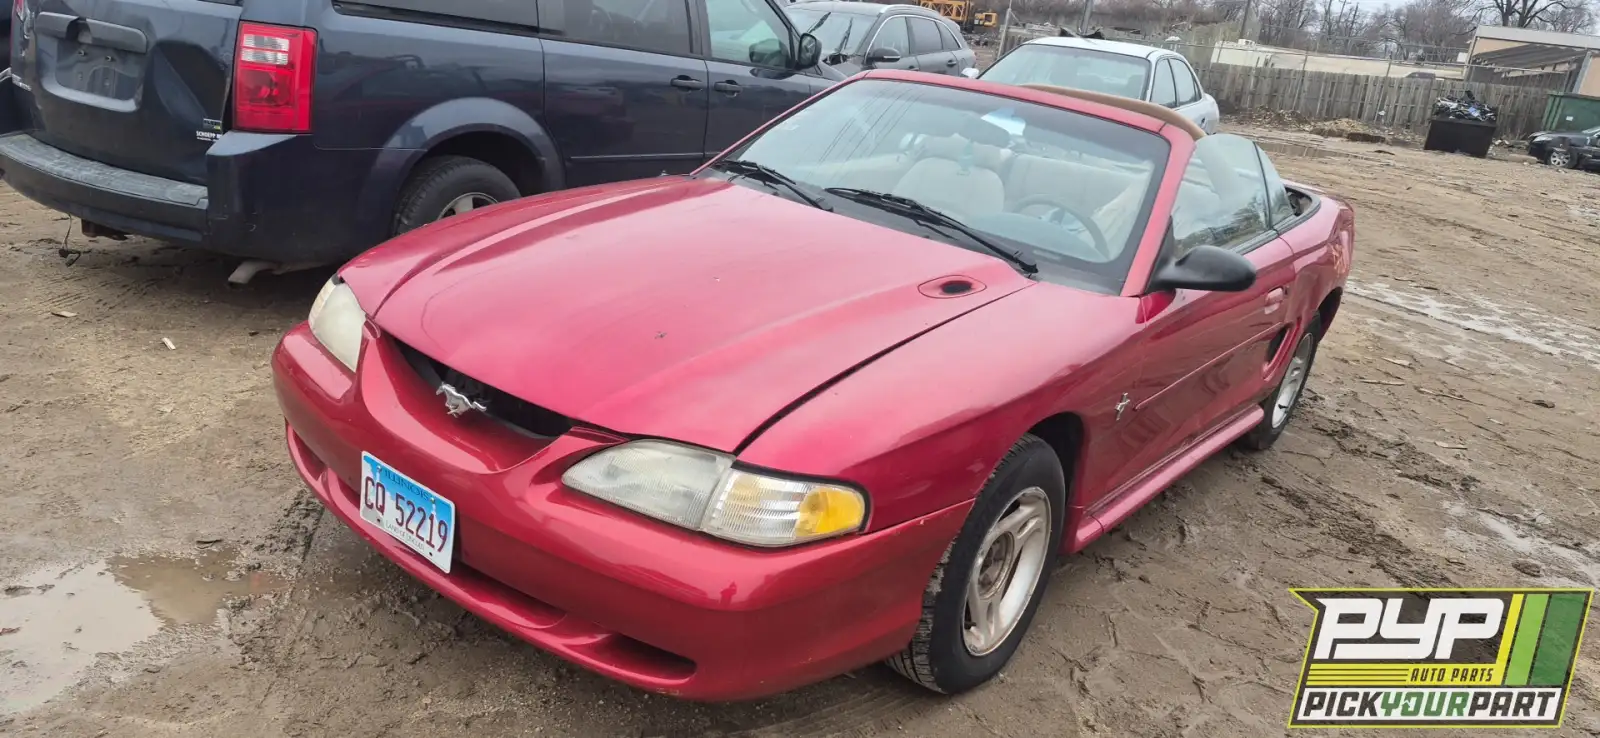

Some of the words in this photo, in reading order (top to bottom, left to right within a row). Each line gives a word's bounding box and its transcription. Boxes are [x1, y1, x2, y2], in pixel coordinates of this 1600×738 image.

[385, 470, 429, 500] ILLINOIS
[365, 476, 385, 515] CQ
[395, 492, 448, 553] 52219
